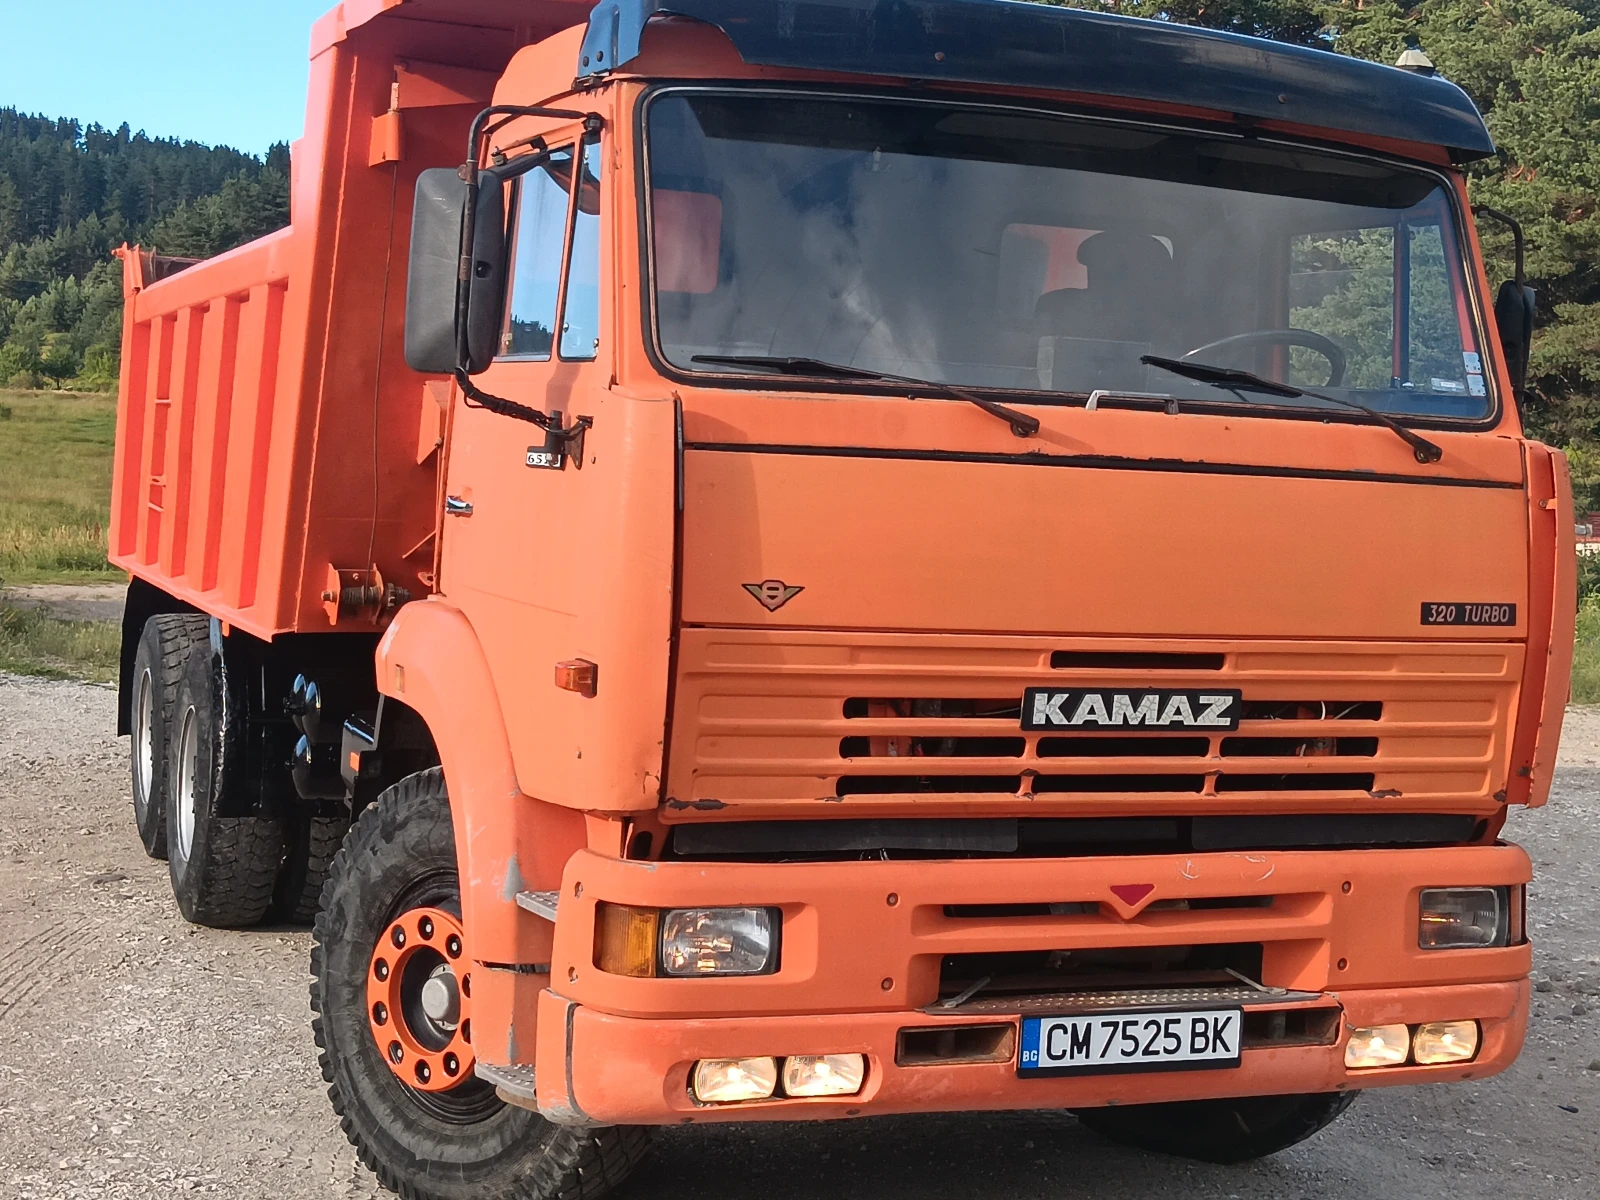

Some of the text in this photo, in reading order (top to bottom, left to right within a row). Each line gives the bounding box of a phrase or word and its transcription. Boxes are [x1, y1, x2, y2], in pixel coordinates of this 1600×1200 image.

[1428, 605, 1509, 622] 320 TURBO
[1032, 693, 1234, 726] KAMAZ
[1046, 1016, 1233, 1061] CM 7525 BK
[1022, 1050, 1038, 1062] BG
